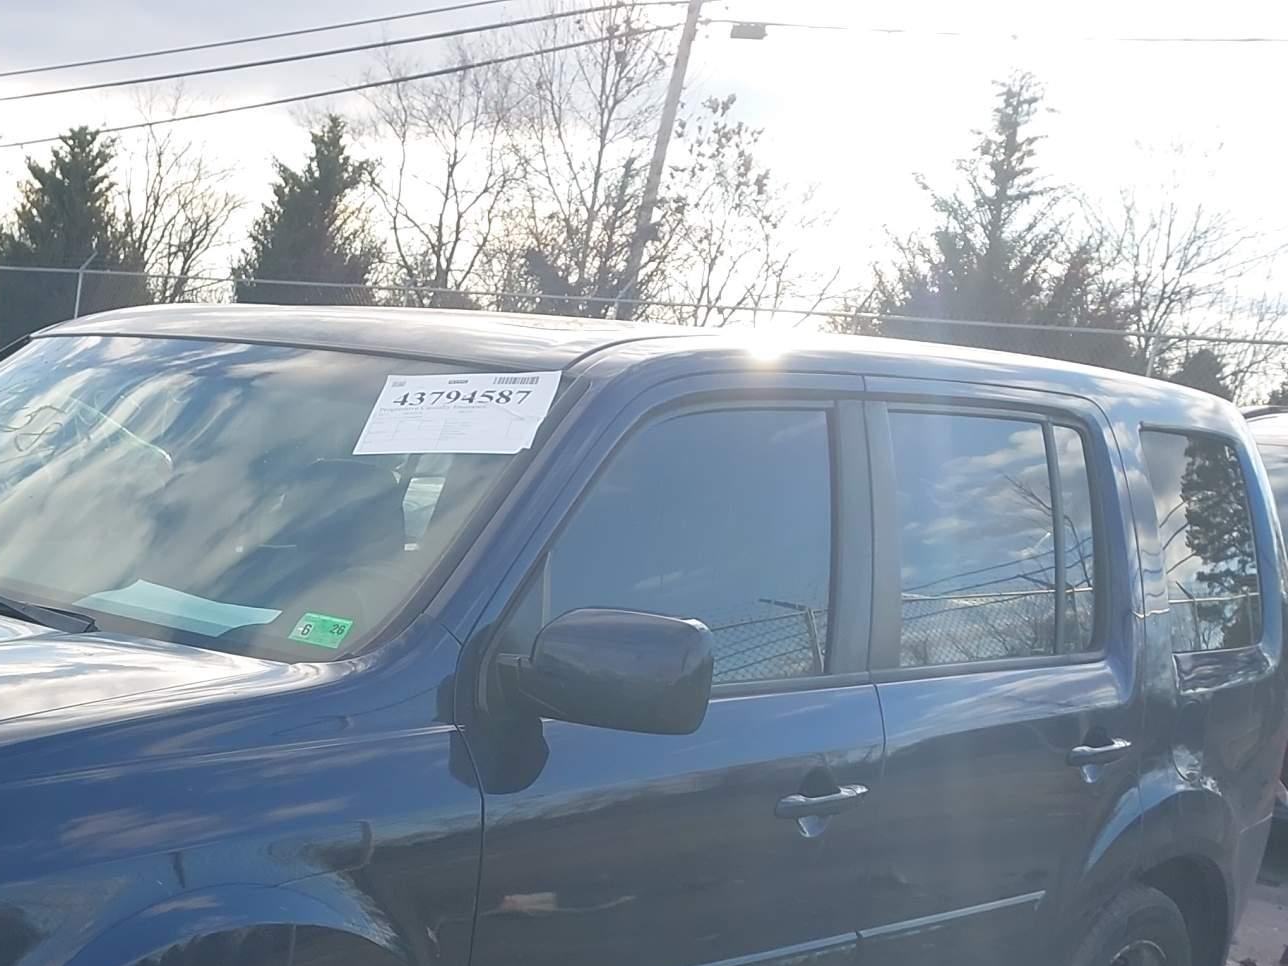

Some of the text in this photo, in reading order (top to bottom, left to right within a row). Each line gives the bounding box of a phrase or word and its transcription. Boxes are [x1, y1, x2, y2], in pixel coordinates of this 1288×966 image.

[392, 390, 533, 407] 43794587
[300, 623, 346, 636] 6 26
